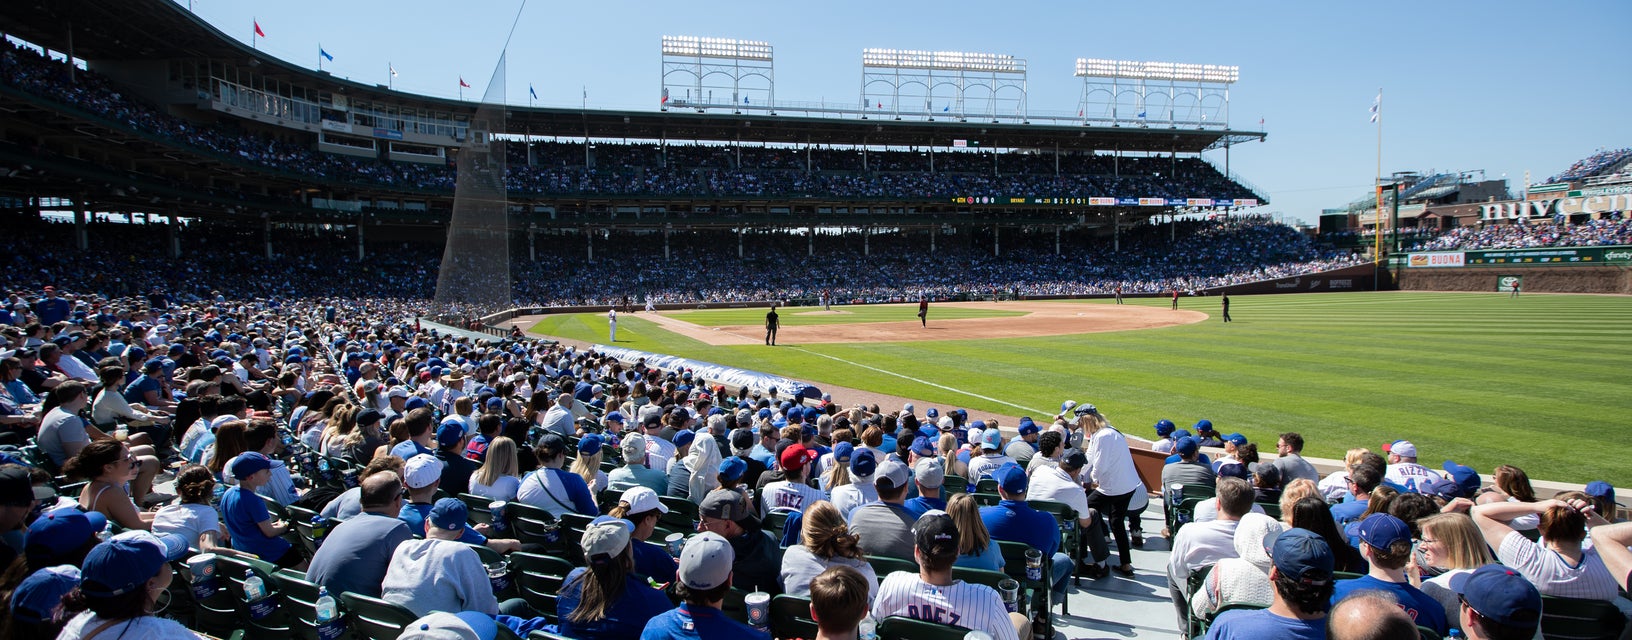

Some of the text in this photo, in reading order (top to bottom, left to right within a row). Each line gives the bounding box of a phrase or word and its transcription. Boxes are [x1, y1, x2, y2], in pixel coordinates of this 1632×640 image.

[1481, 195, 1632, 220] nuveen
[1431, 255, 1461, 264] BUONA
[1398, 465, 1428, 477] RIZZO
[775, 492, 804, 509] BAEZ
[908, 604, 961, 625] BAEZ
